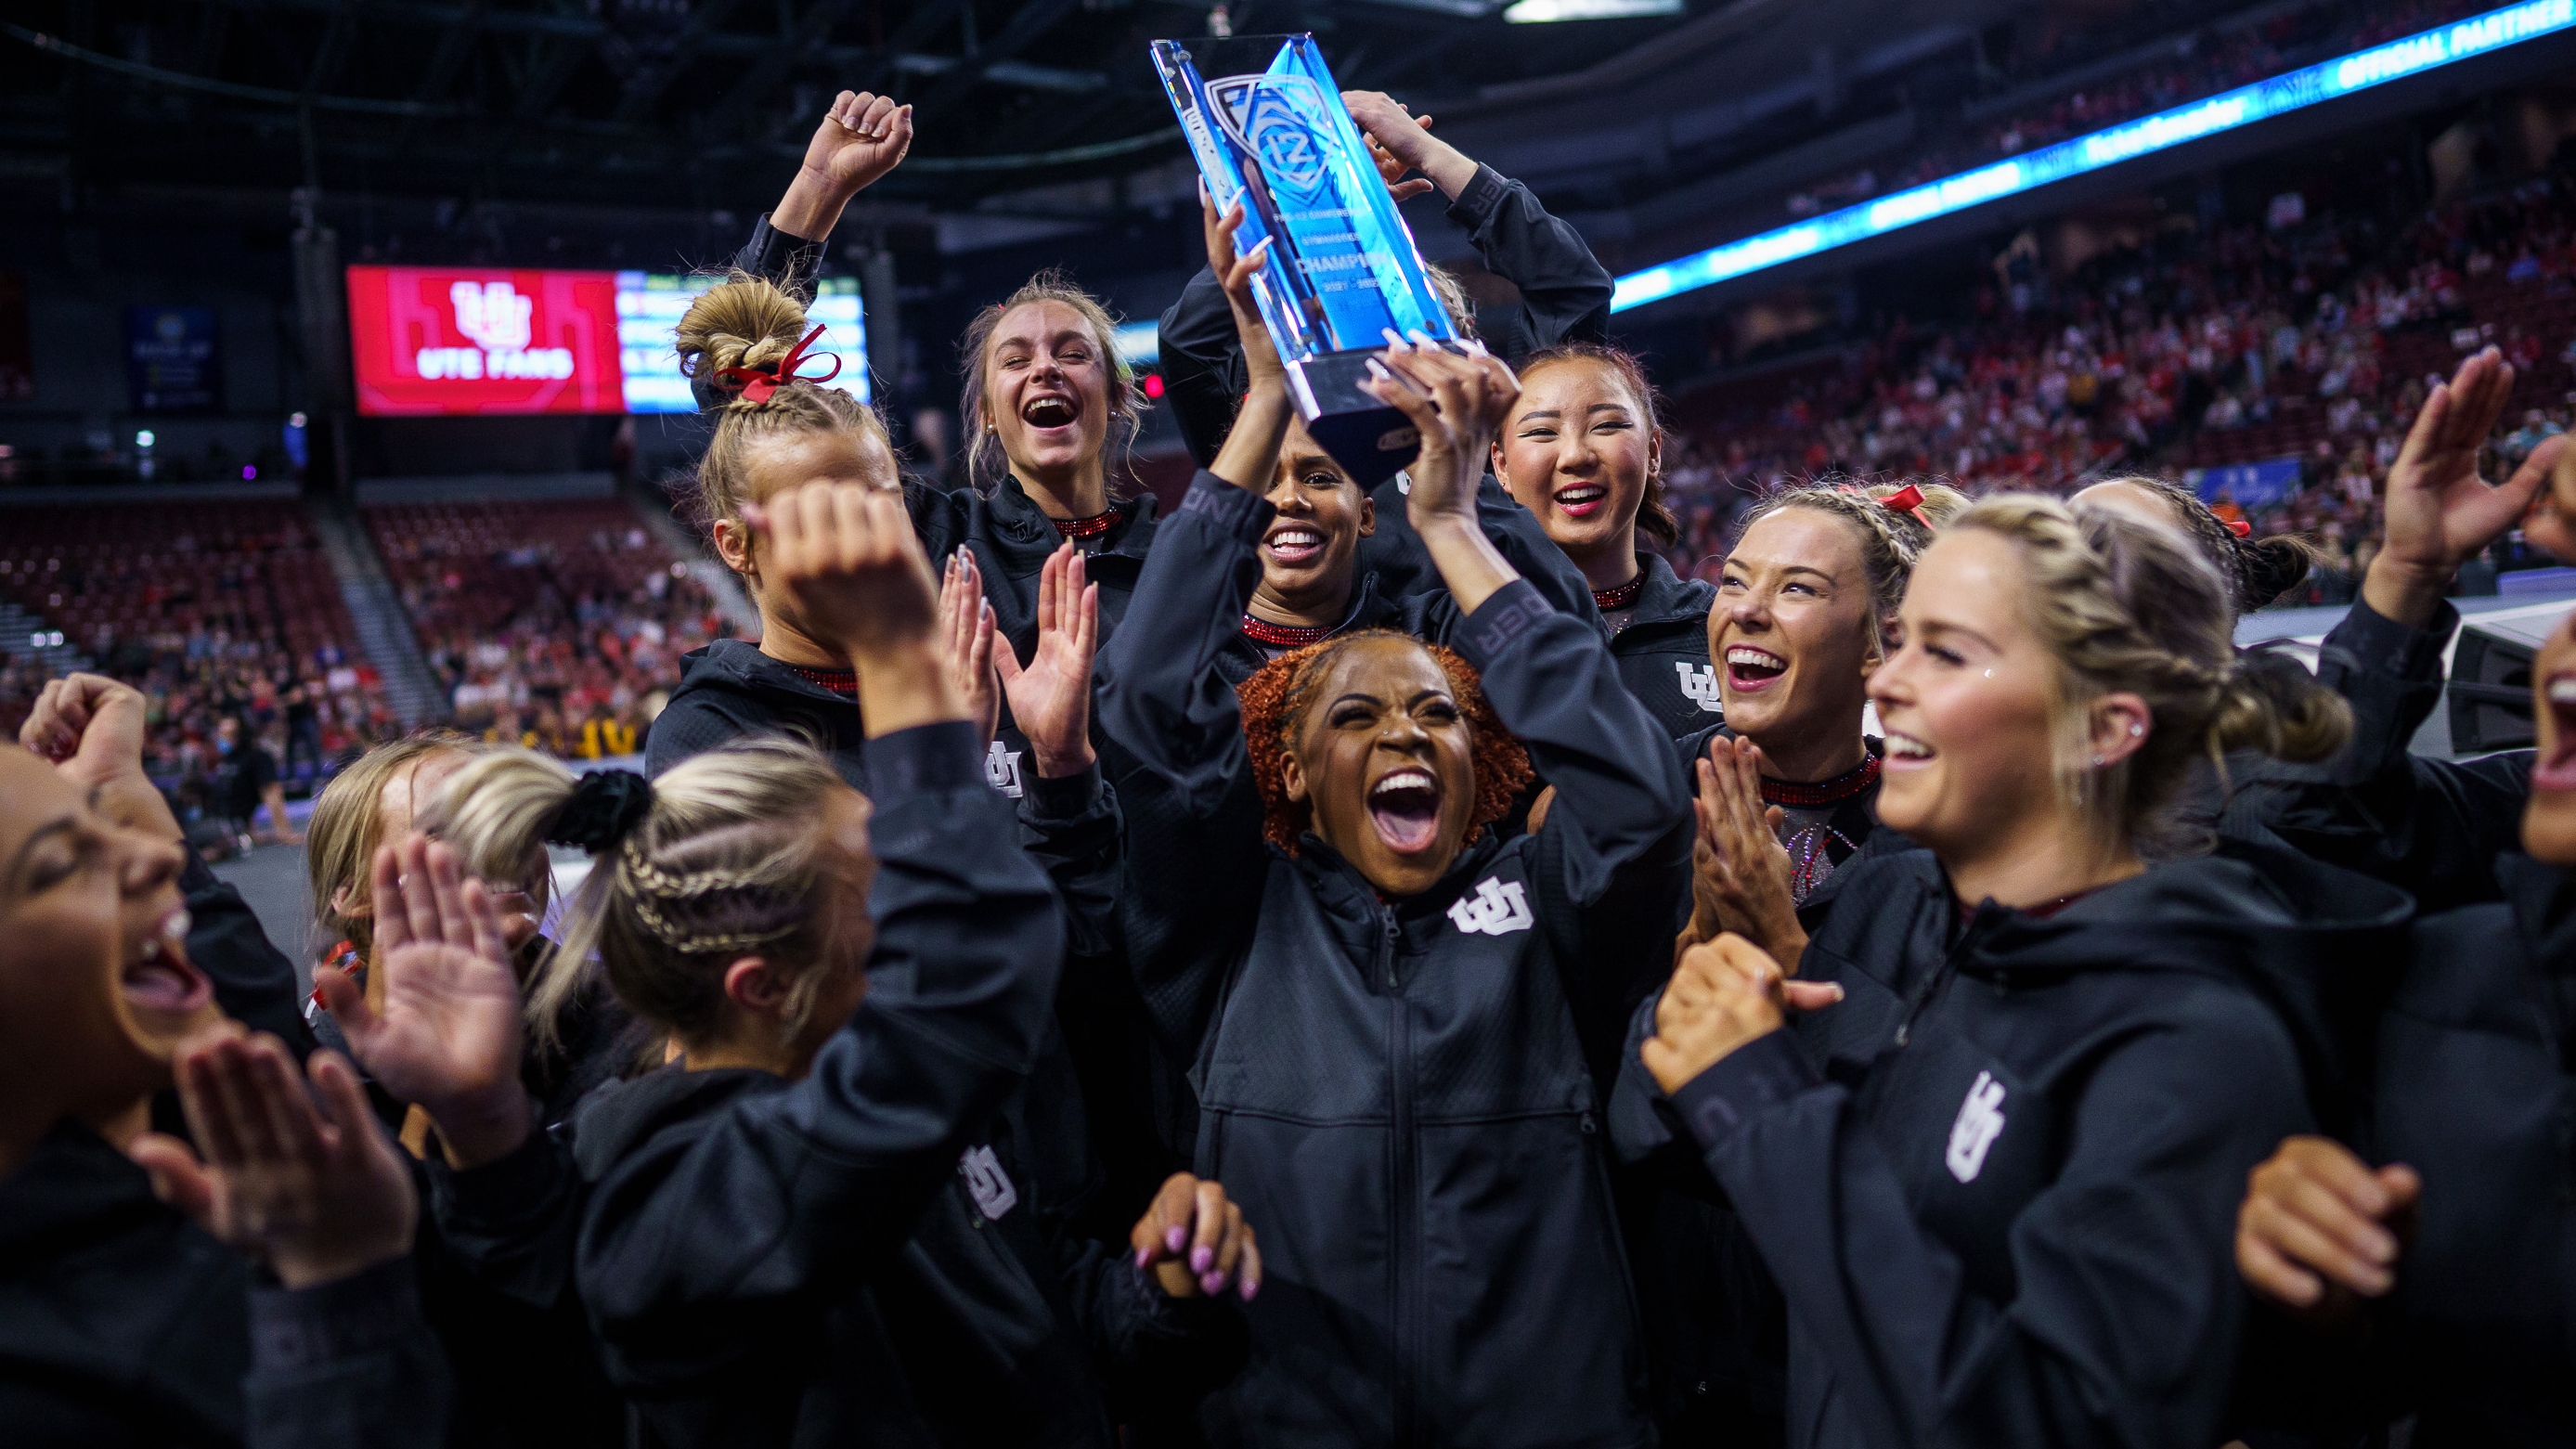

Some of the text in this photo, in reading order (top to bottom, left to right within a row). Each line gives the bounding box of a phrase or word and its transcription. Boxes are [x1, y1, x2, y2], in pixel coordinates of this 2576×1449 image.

[2337, 0, 2573, 89] OFFICIAL PARTNER
[1308, 206, 1366, 221] CONFERE
[418, 347, 574, 380] UTE FANS
